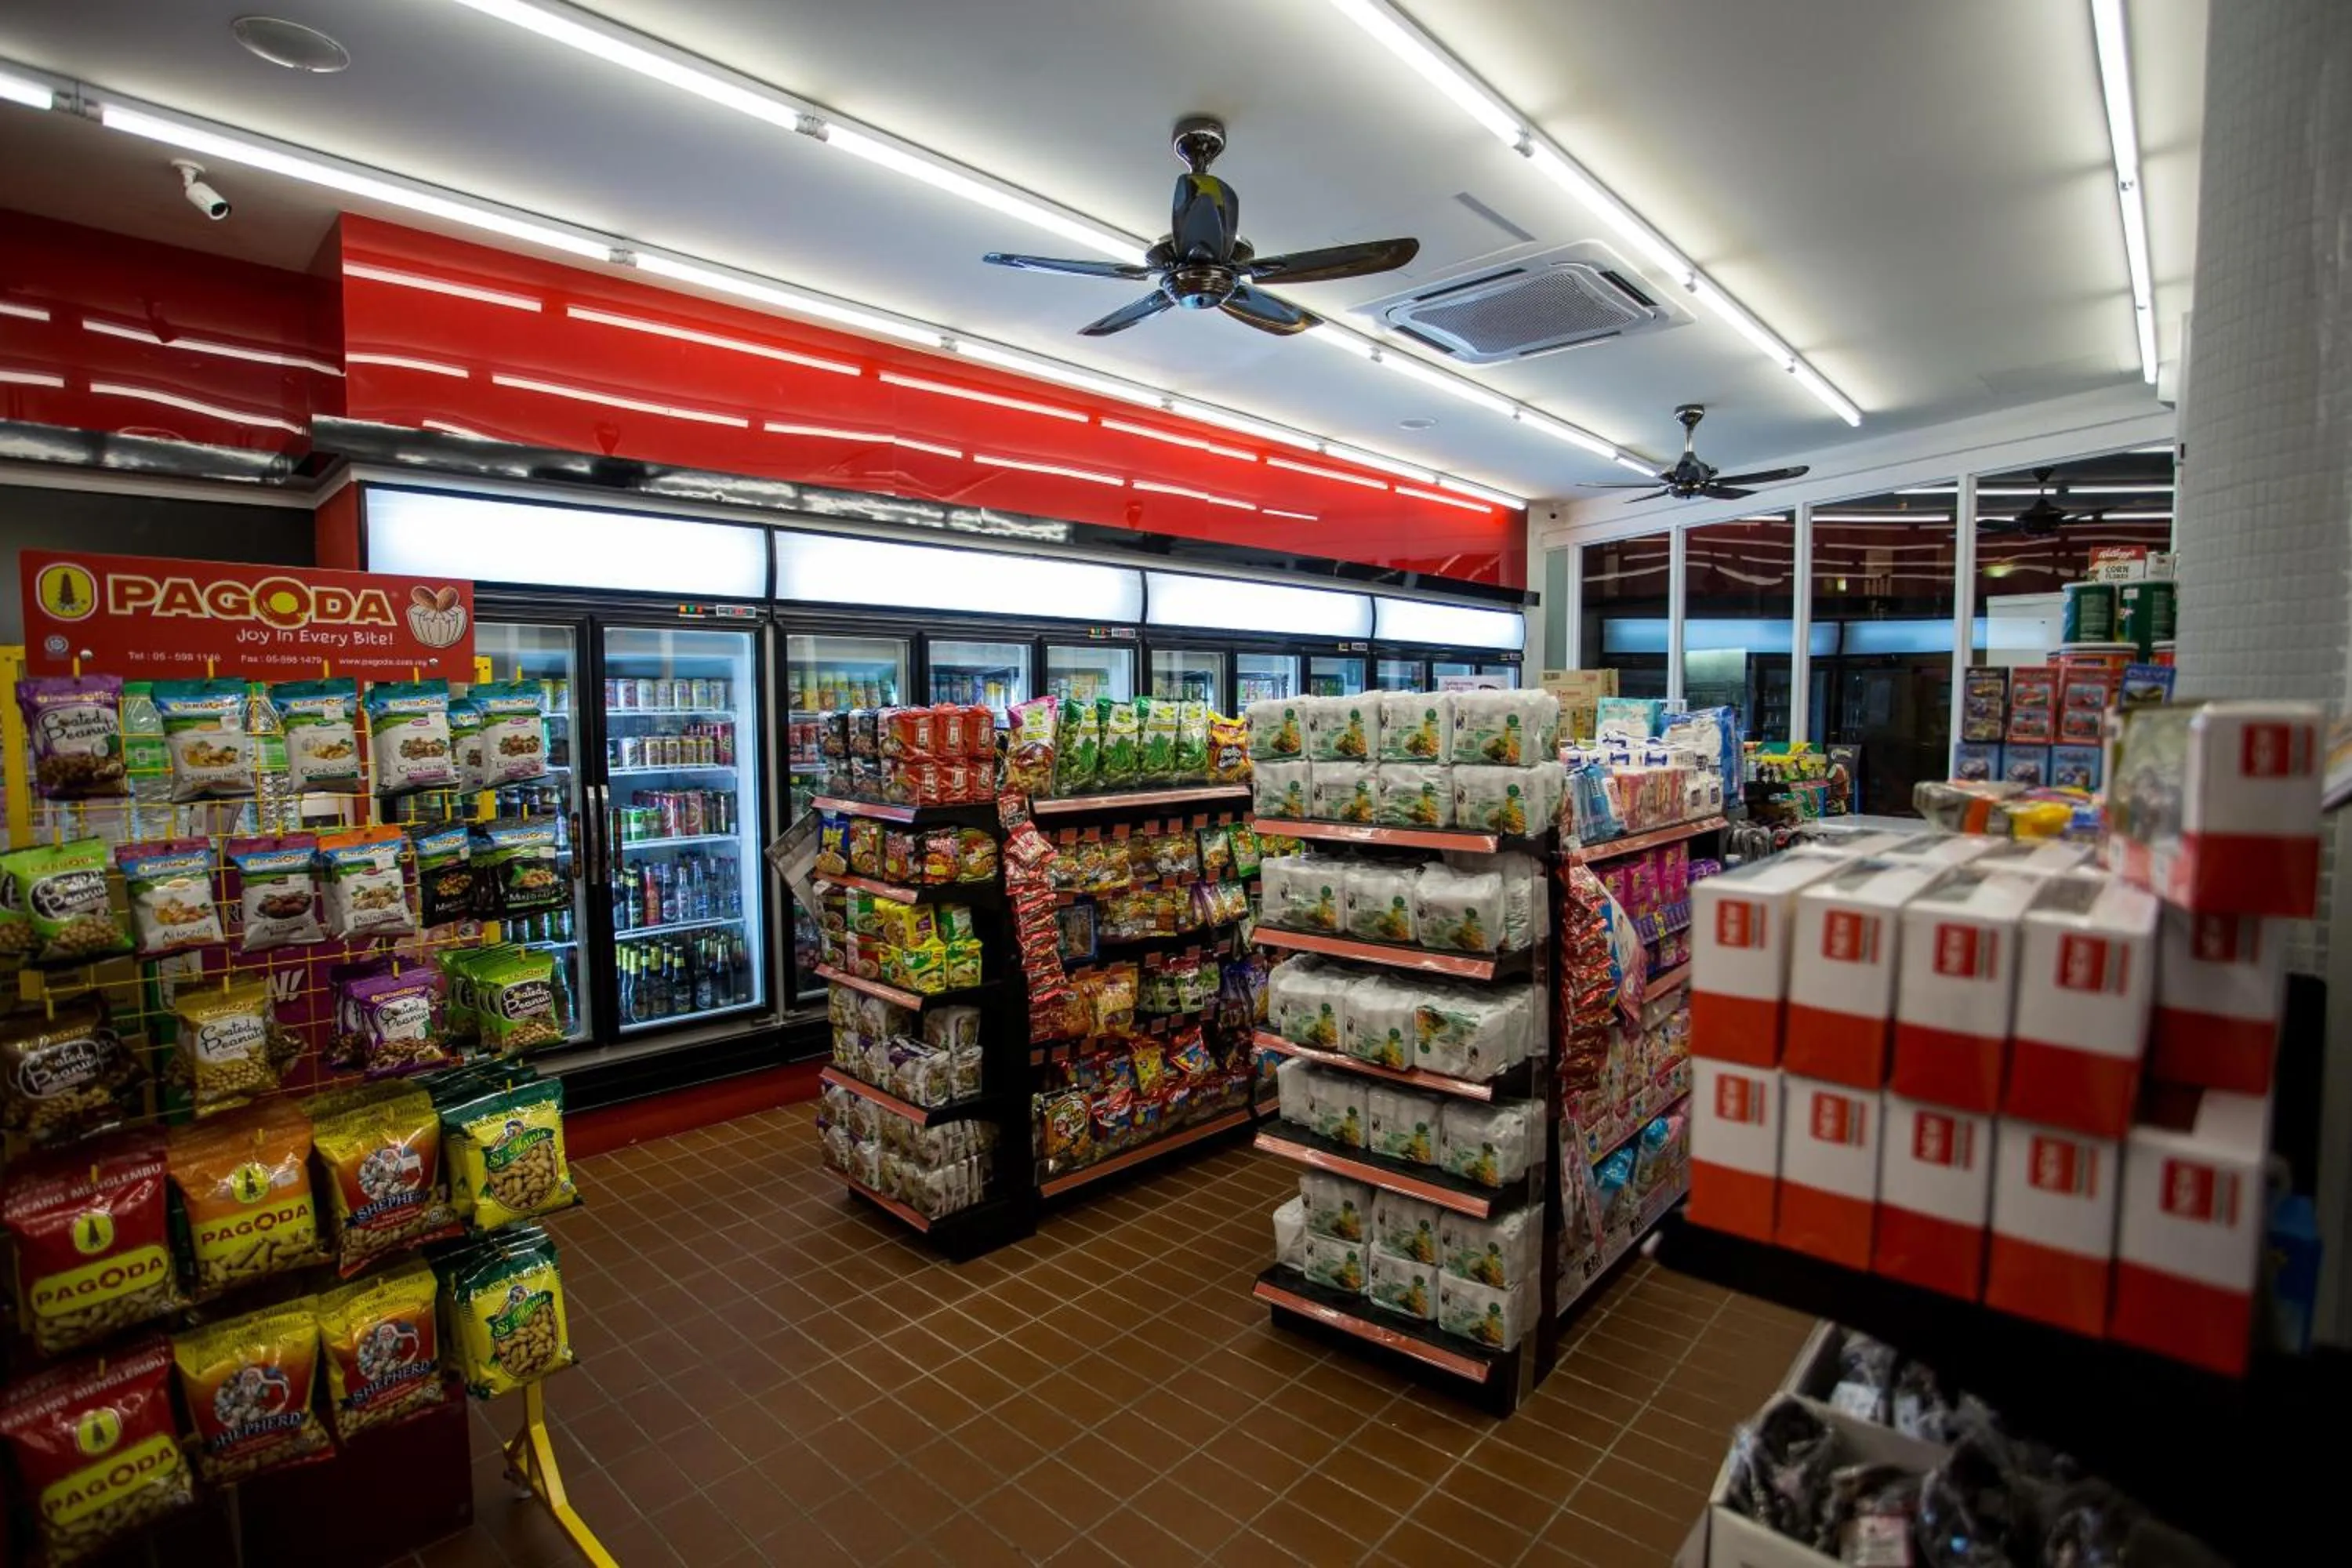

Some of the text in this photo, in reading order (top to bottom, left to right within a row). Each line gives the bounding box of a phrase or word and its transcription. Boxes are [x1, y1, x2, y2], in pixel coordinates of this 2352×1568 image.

[2105, 564, 2129, 574] CORN
[107, 574, 397, 630] PAGODA
[128, 651, 144, 661] Tel
[236, 628, 270, 645] Joy
[299, 630, 348, 647] Every
[353, 631, 395, 646] Bite!
[200, 1203, 309, 1247] PAGODA
[36, 1256, 164, 1306] PAGODA
[43, 1446, 175, 1516] PAGODA
